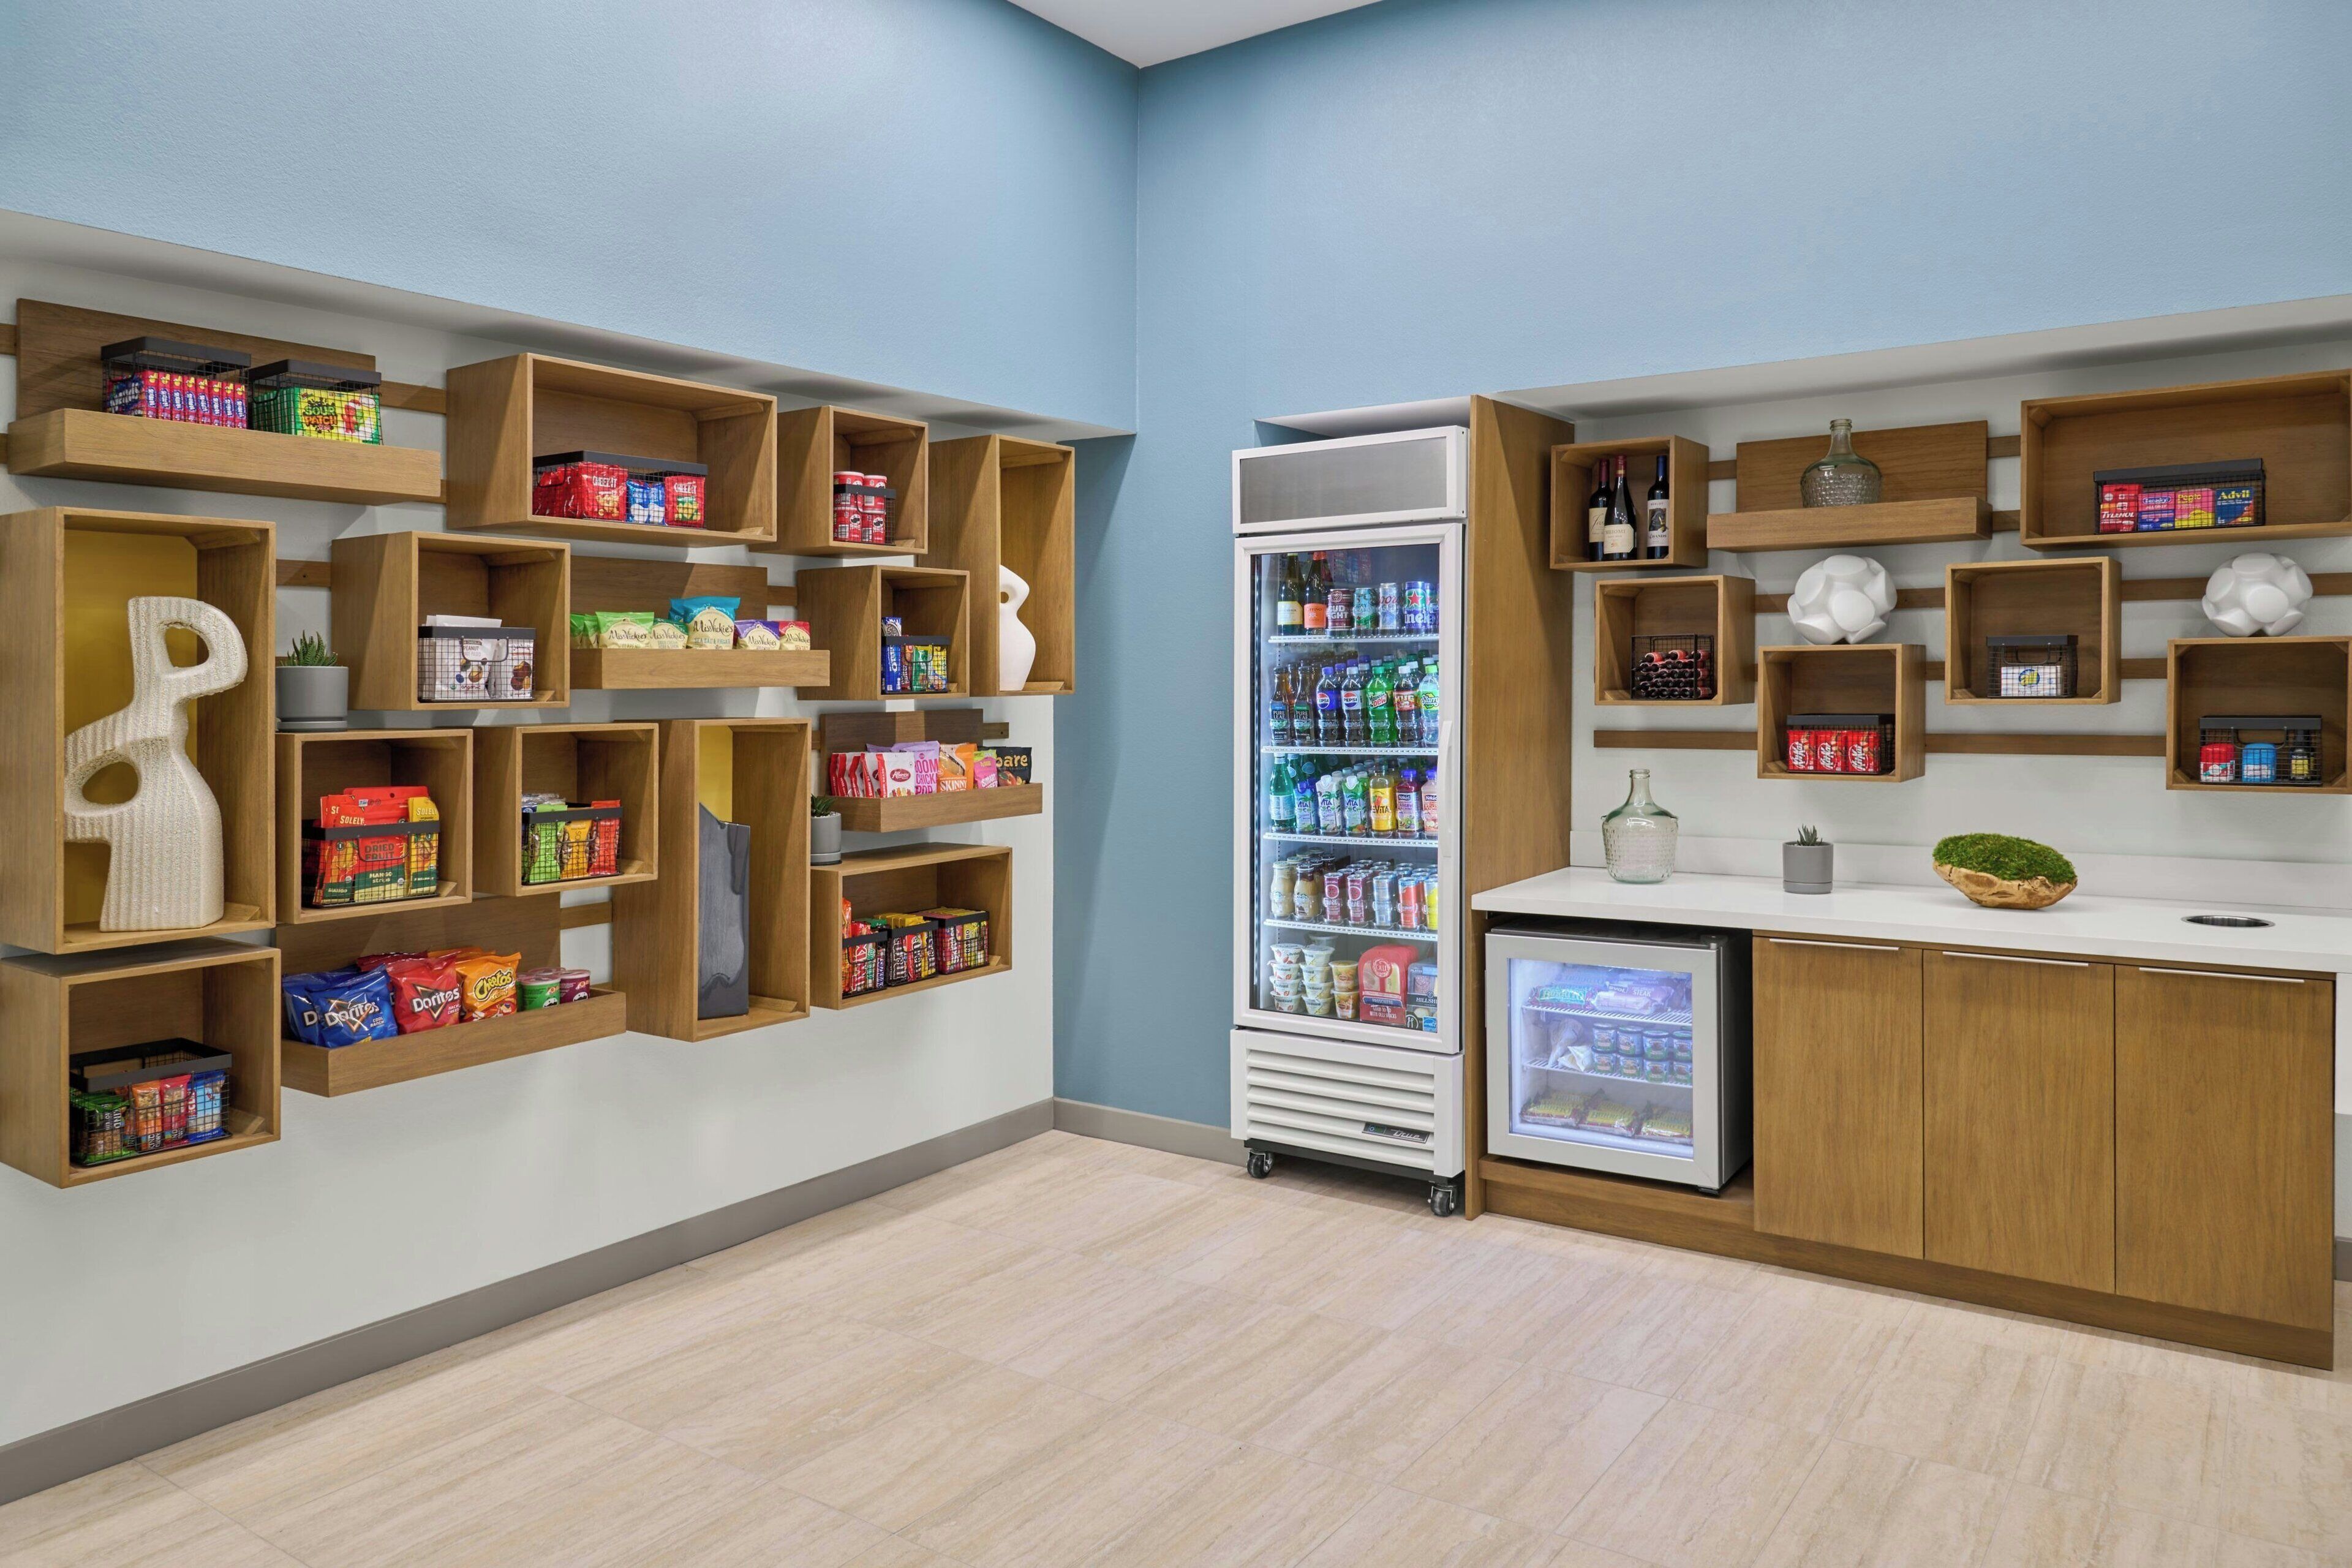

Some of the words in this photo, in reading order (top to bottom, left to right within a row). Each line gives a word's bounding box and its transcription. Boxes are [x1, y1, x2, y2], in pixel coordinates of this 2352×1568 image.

[305, 405, 335, 416] SOUR
[304, 415, 337, 425] PATCH
[2217, 489, 2251, 500] Advil
[2019, 669, 2038, 687] all
[940, 780, 967, 791] SKINNY
[340, 815, 364, 825] SOLELY
[364, 843, 394, 853] DRIED
[364, 852, 394, 861] FRUIT
[475, 970, 512, 1000] Cheetos
[1632, 989, 1651, 998] STEAK
[412, 987, 460, 1012] Doritos
[324, 1001, 380, 1027] Doritos
